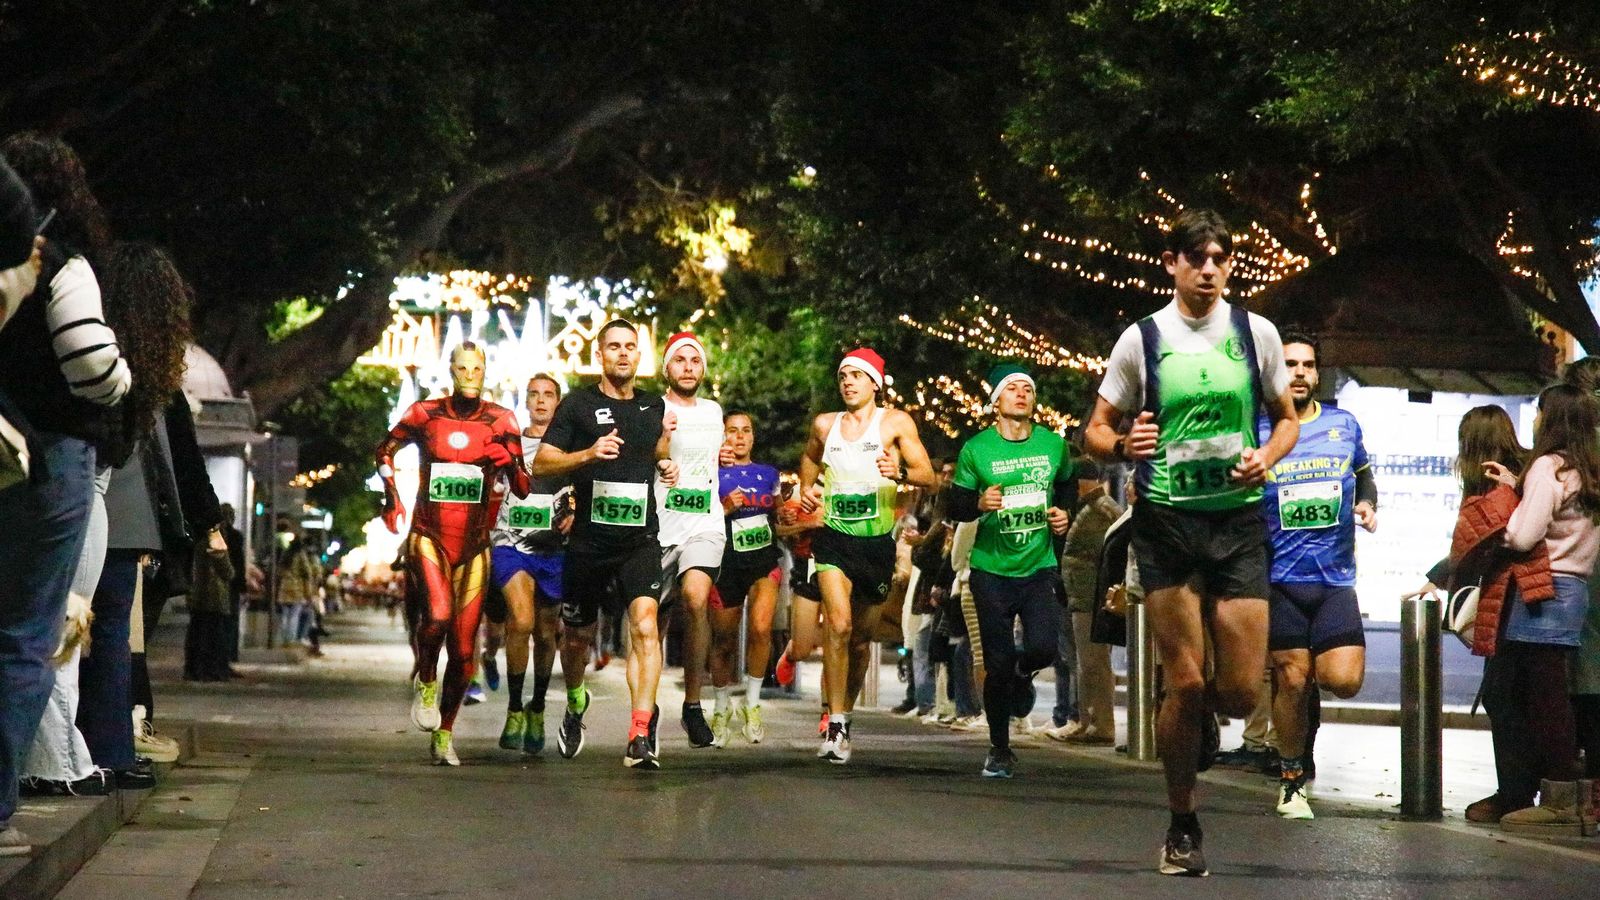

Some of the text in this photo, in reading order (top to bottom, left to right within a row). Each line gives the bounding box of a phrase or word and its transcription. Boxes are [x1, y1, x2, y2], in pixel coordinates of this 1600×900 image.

[1019, 455, 1049, 463] SILVESTRE
[1275, 458, 1331, 474] BREAKING
[992, 464, 1015, 472] CIUDAD
[433, 482, 478, 497] 1106
[673, 494, 705, 510] 948
[836, 500, 868, 514] 955
[512, 511, 543, 525] 979
[596, 502, 643, 520] 1579
[1001, 510, 1044, 528] 1788
[1291, 504, 1332, 523] 483
[736, 530, 769, 547] 1962
